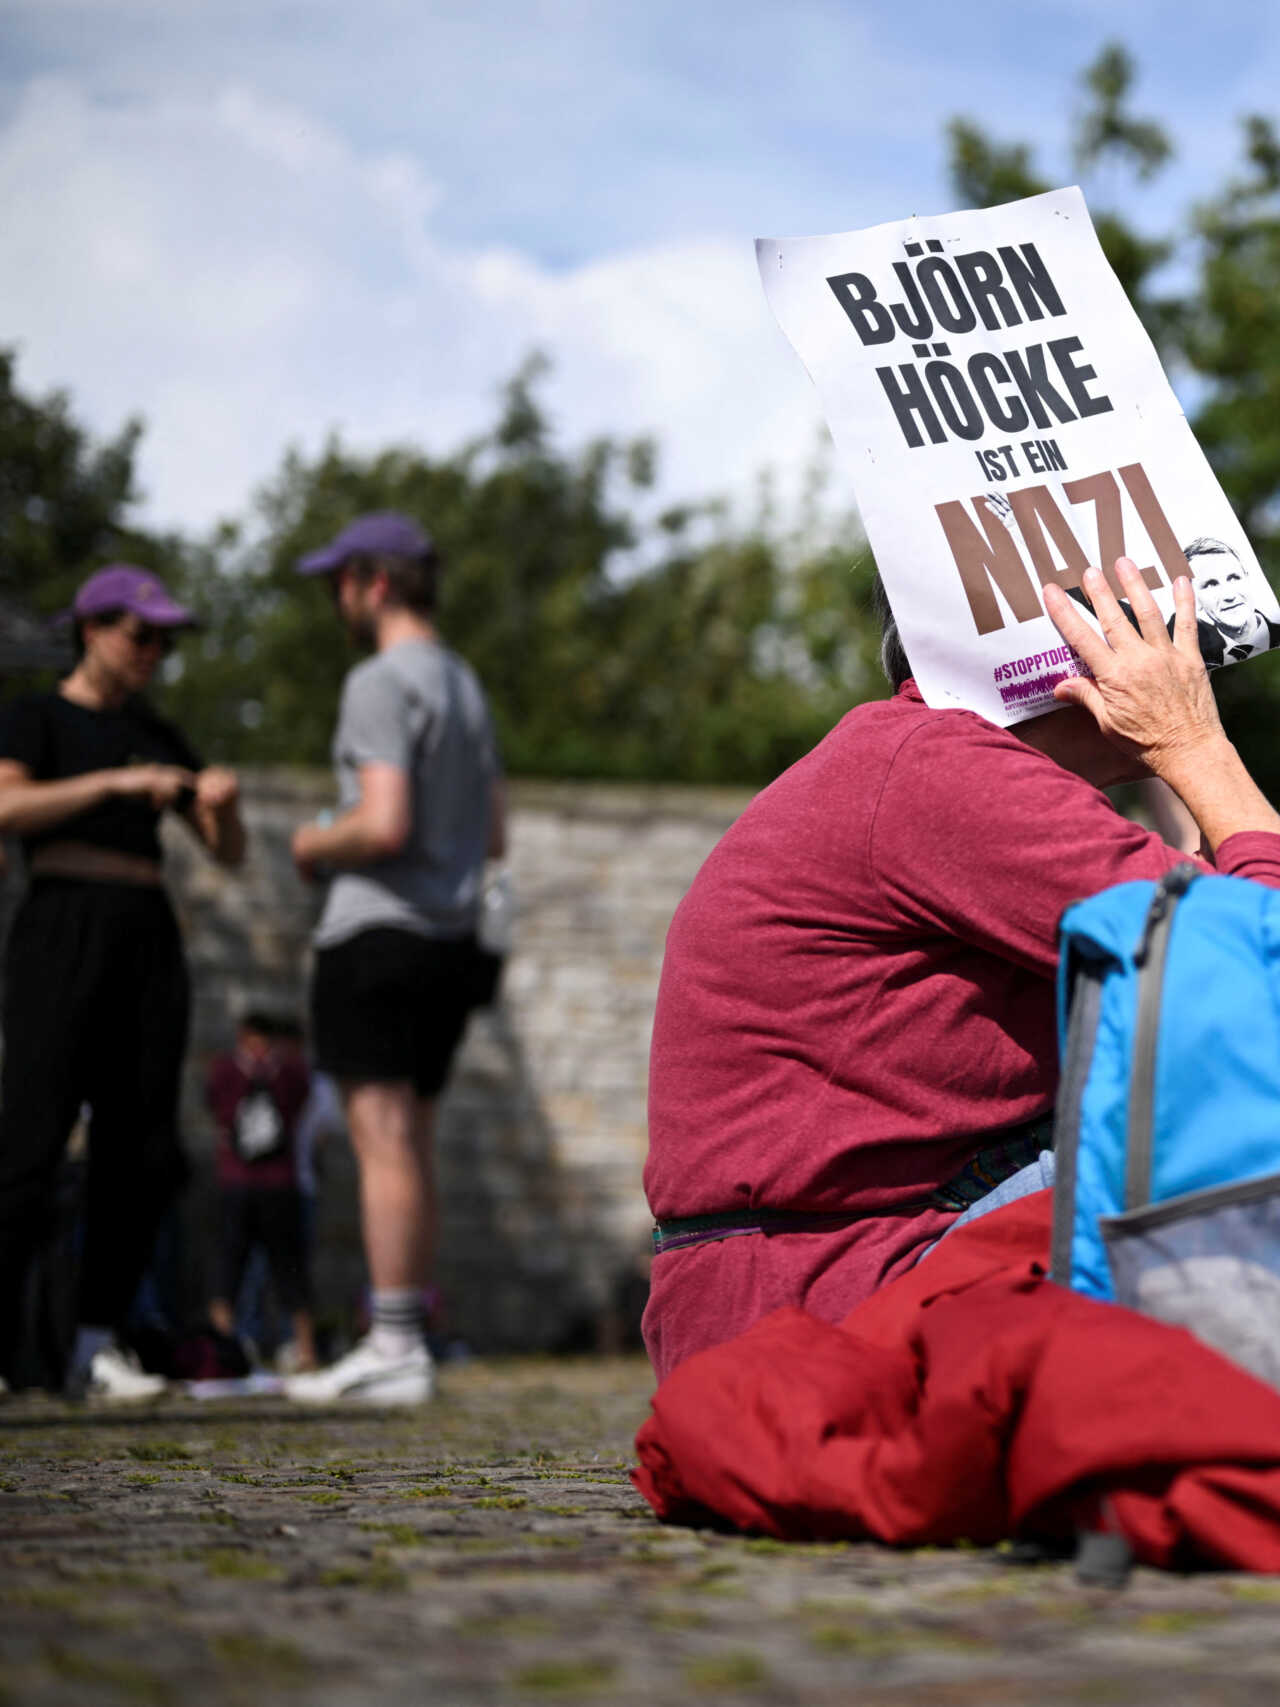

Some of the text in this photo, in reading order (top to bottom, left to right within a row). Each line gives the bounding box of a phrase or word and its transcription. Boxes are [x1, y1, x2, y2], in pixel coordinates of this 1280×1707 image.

[825, 239, 1067, 347] BJÖRN
[875, 335, 1114, 449] HÖCKE
[974, 439, 1069, 482] IST EIN
[935, 462, 1196, 636] NAZI
